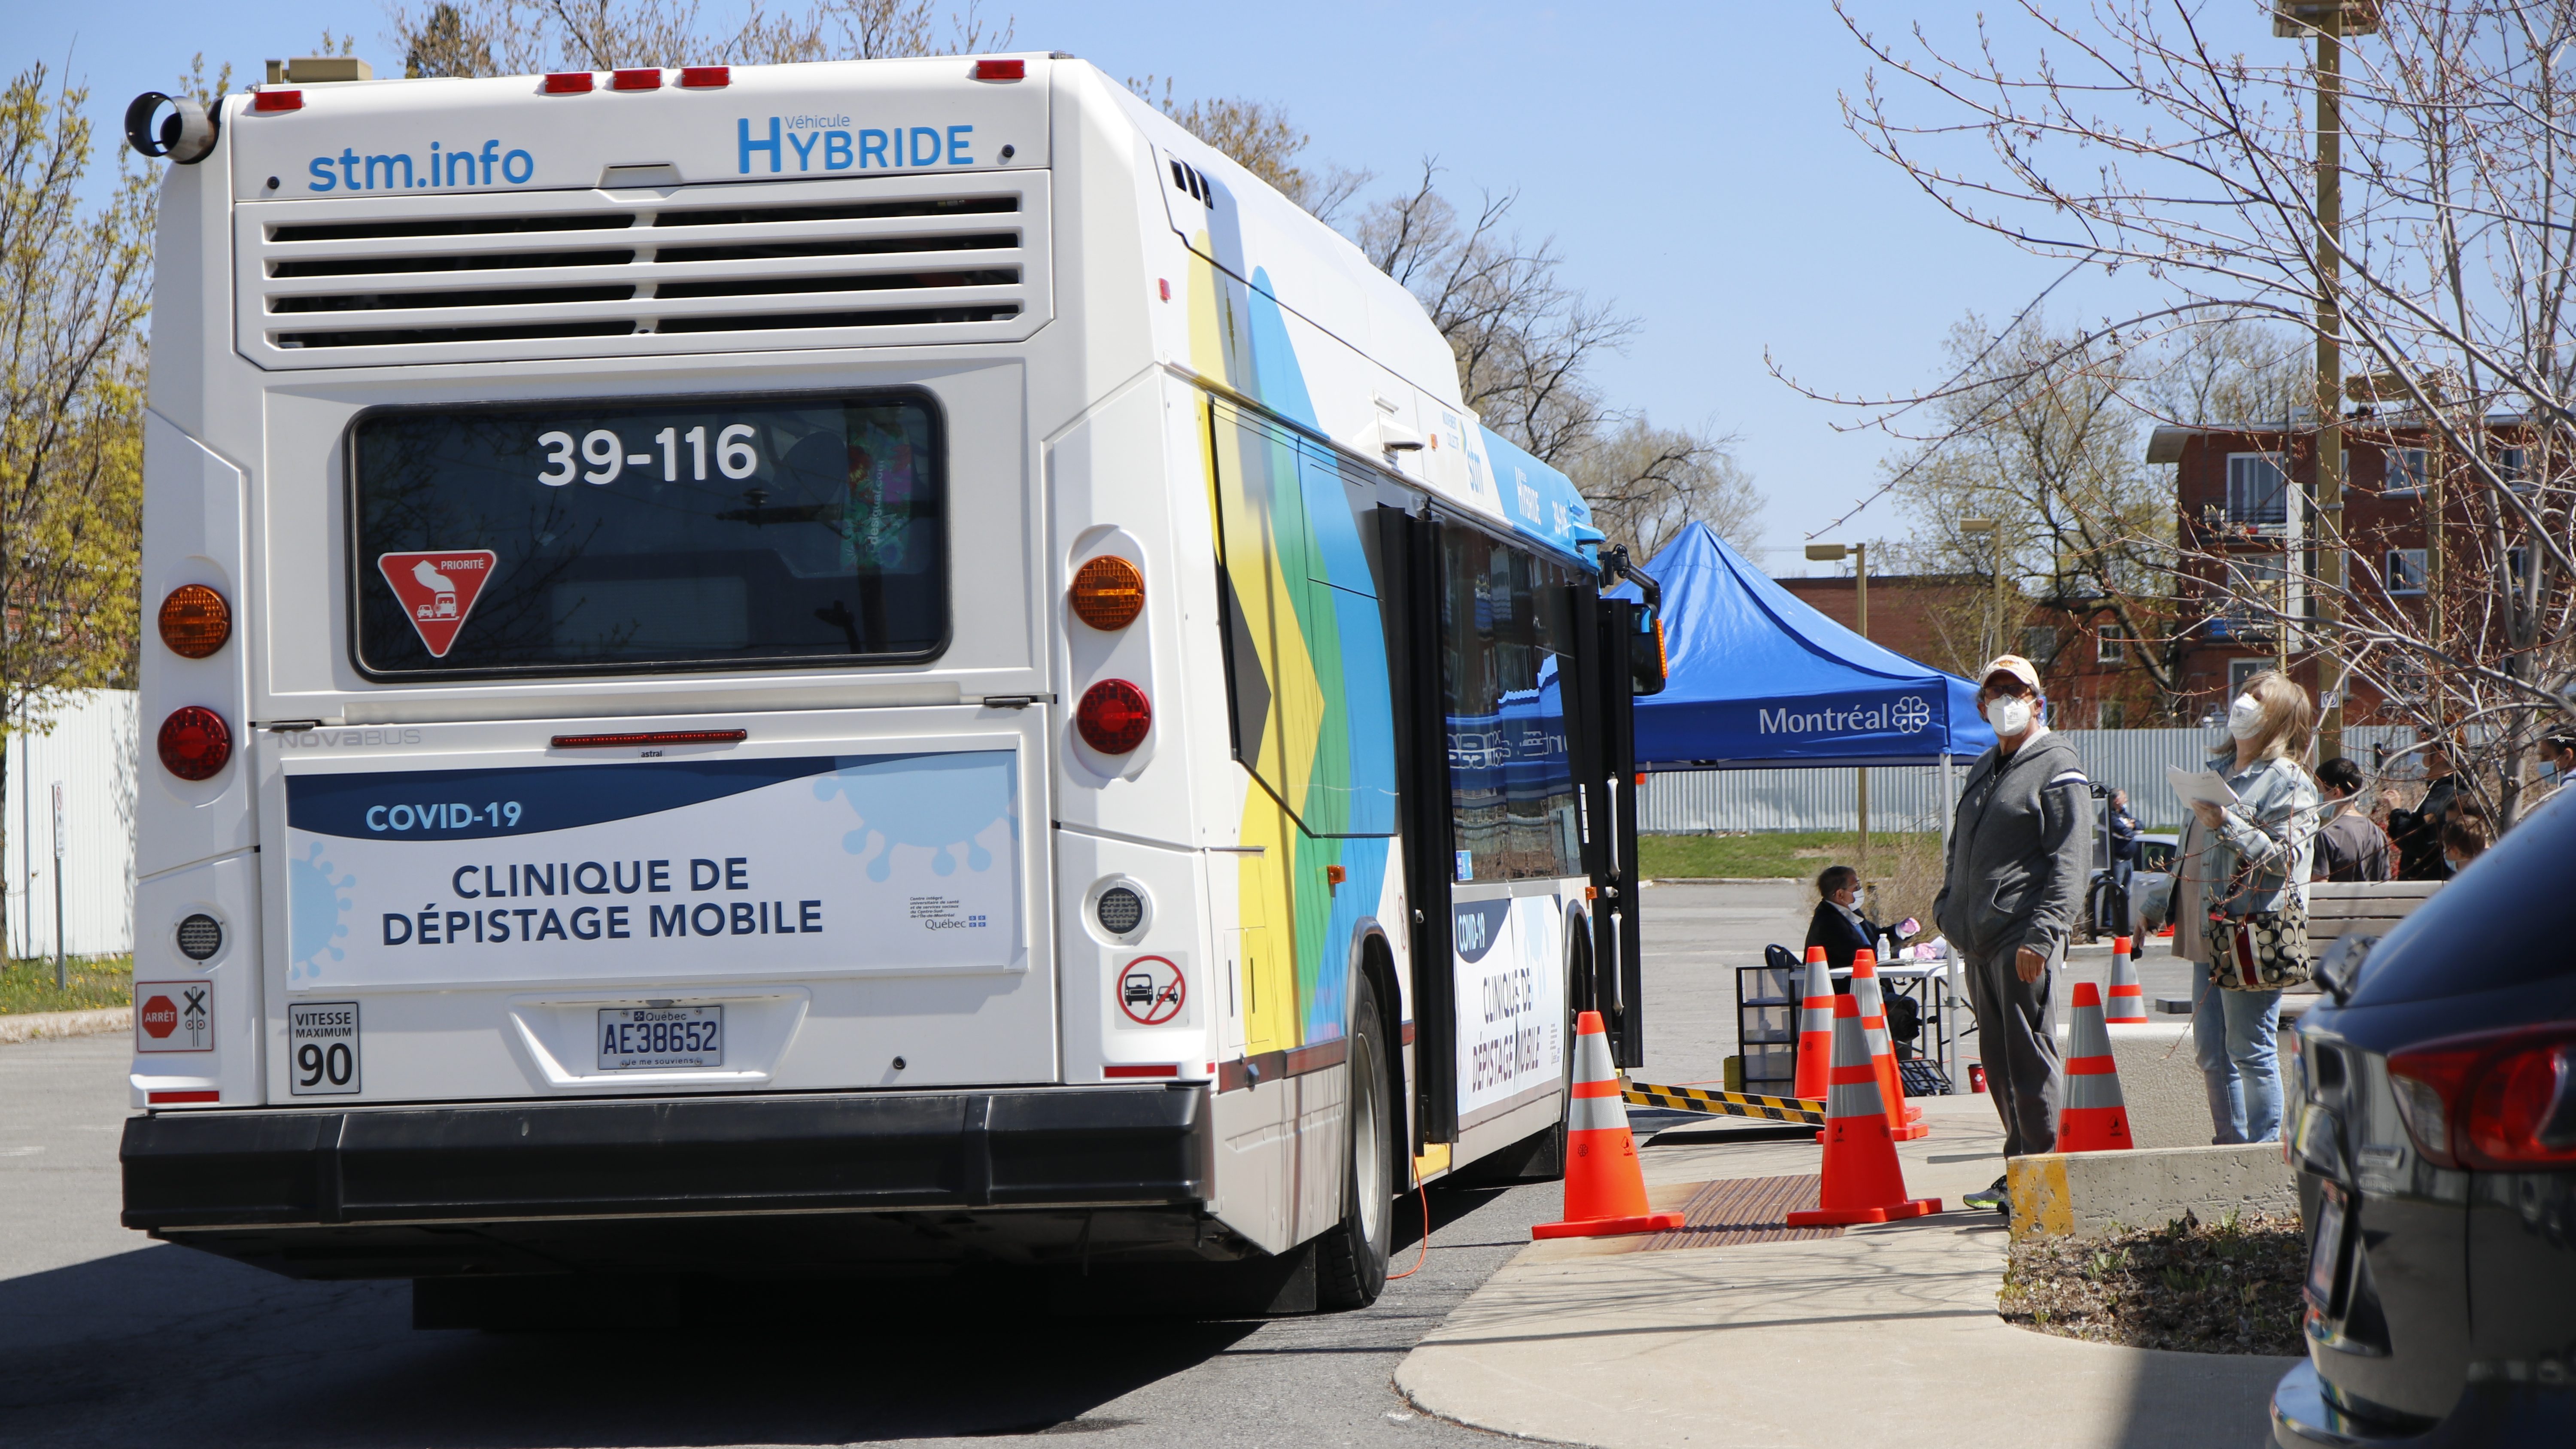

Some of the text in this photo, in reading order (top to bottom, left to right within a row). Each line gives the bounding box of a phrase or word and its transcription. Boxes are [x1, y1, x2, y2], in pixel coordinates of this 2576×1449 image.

[784, 114, 850, 129] Véhicule
[738, 117, 974, 174] HYBRIDE
[309, 140, 534, 192] stm.info
[537, 424, 756, 486] 39-116
[1467, 441, 1484, 496] stm
[1515, 466, 1542, 526] HYBRIDE
[440, 557, 485, 571] PRIORITÉ
[1759, 703, 1887, 735] Montréal
[641, 750, 662, 758] astral
[366, 801, 522, 831] COVID-19
[452, 857, 748, 899] CLINIQUE DE
[383, 900, 823, 946] DÉPISTAGE MOBILE
[925, 919, 966, 931] Québec
[1458, 912, 1485, 953] COVID-19
[1483, 968, 1531, 1024] CLINIQUE DE
[145, 1009, 175, 1023] ARRÊT
[295, 1012, 352, 1026] VITESSE
[295, 1027, 352, 1038] MAXIMUM
[645, 1012, 687, 1021] Québec
[603, 1021, 717, 1054] AE38652
[298, 1043, 352, 1087] 90
[1472, 1031, 1513, 1093] DÉPISTAGE
[1517, 1026, 1540, 1075] MOBILE
